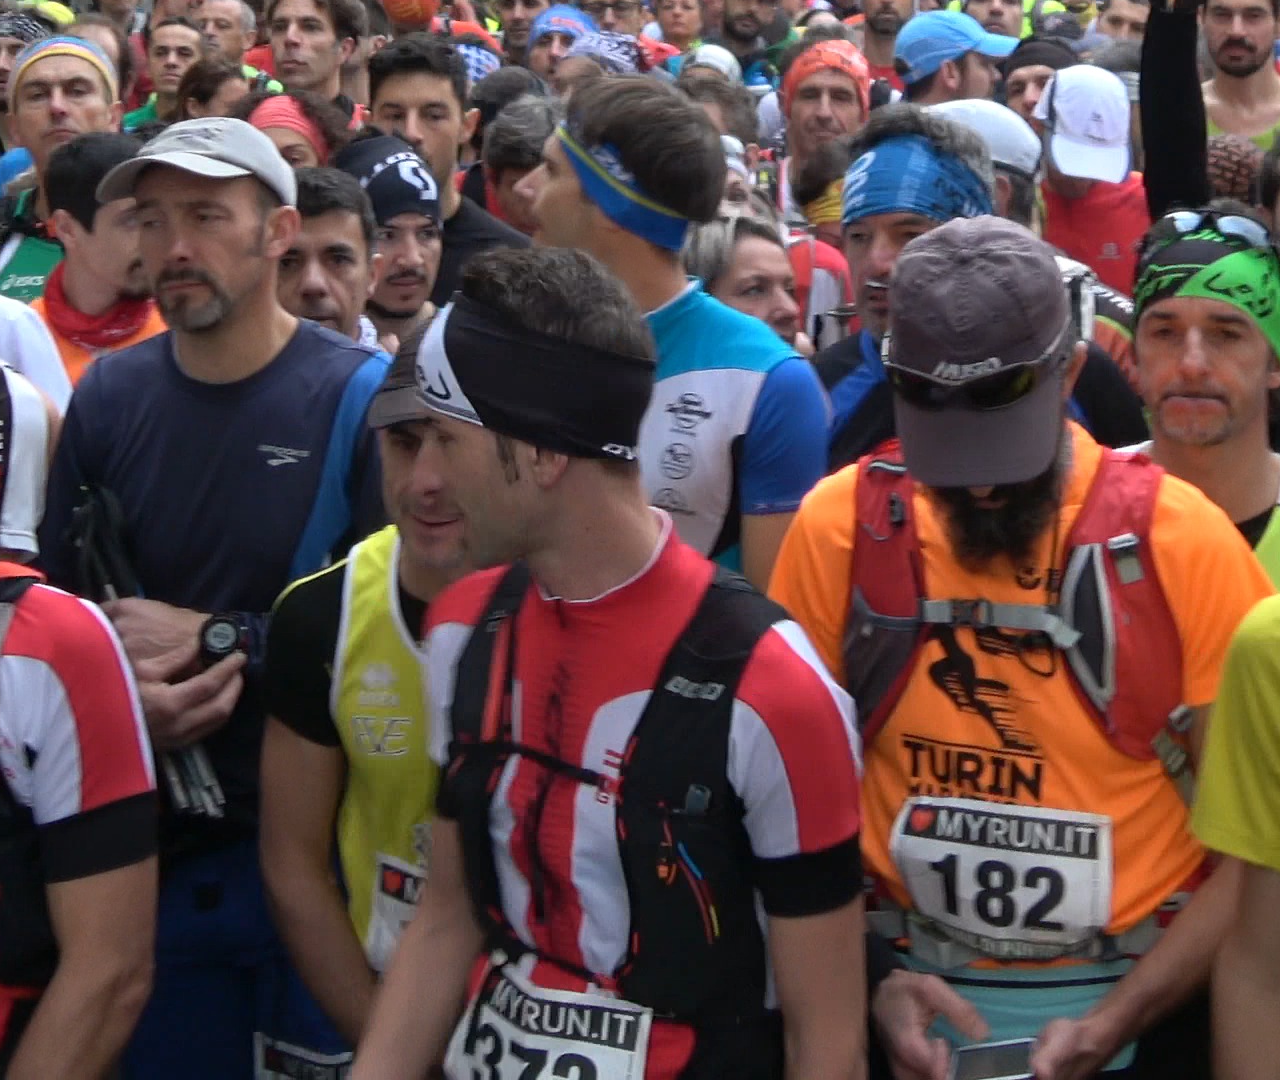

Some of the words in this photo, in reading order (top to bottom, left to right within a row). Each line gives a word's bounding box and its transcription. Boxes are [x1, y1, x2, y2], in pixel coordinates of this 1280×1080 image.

[901, 739, 1043, 801] TURIN
[935, 809, 1096, 855] MYRUN.IT
[928, 853, 1065, 931] 182
[490, 978, 636, 1045] MYRUN.IT
